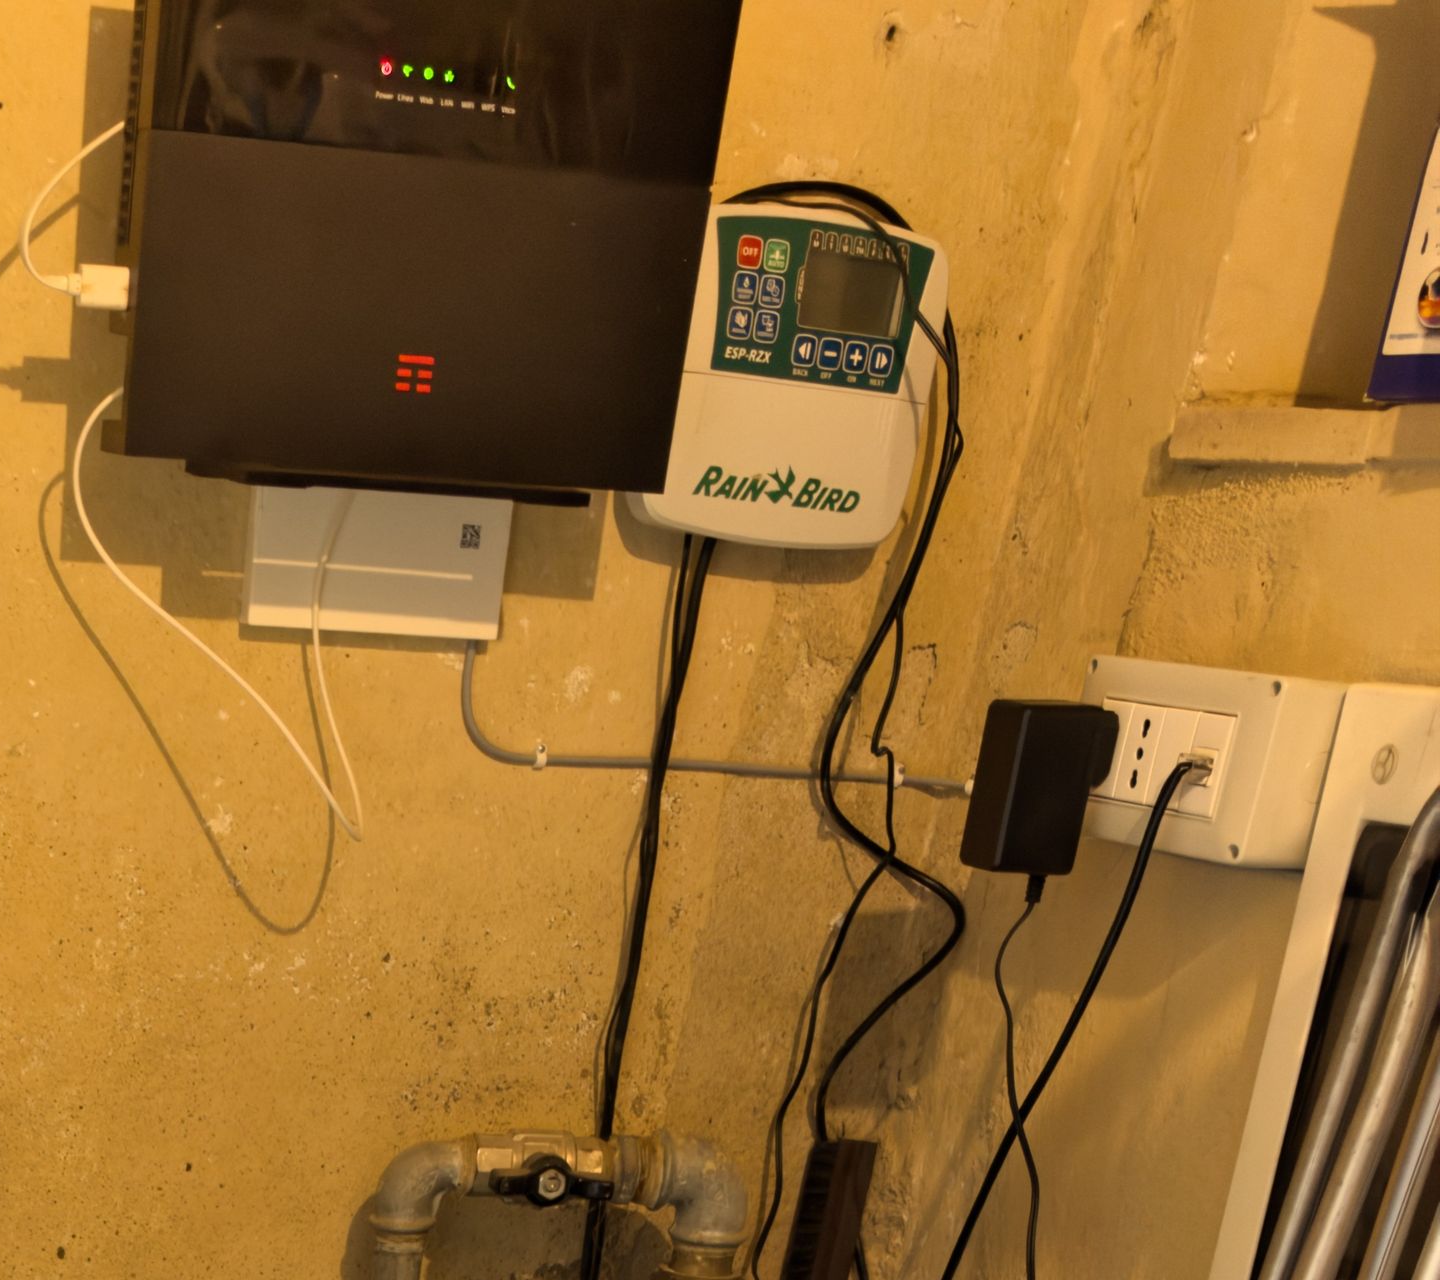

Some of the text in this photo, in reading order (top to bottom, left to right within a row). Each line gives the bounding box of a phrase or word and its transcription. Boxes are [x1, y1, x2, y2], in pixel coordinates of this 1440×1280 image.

[375, 91, 394, 100] Power
[742, 247, 758, 257] OFF
[724, 346, 772, 363] ESP-RZX
[792, 368, 808, 377] BACK
